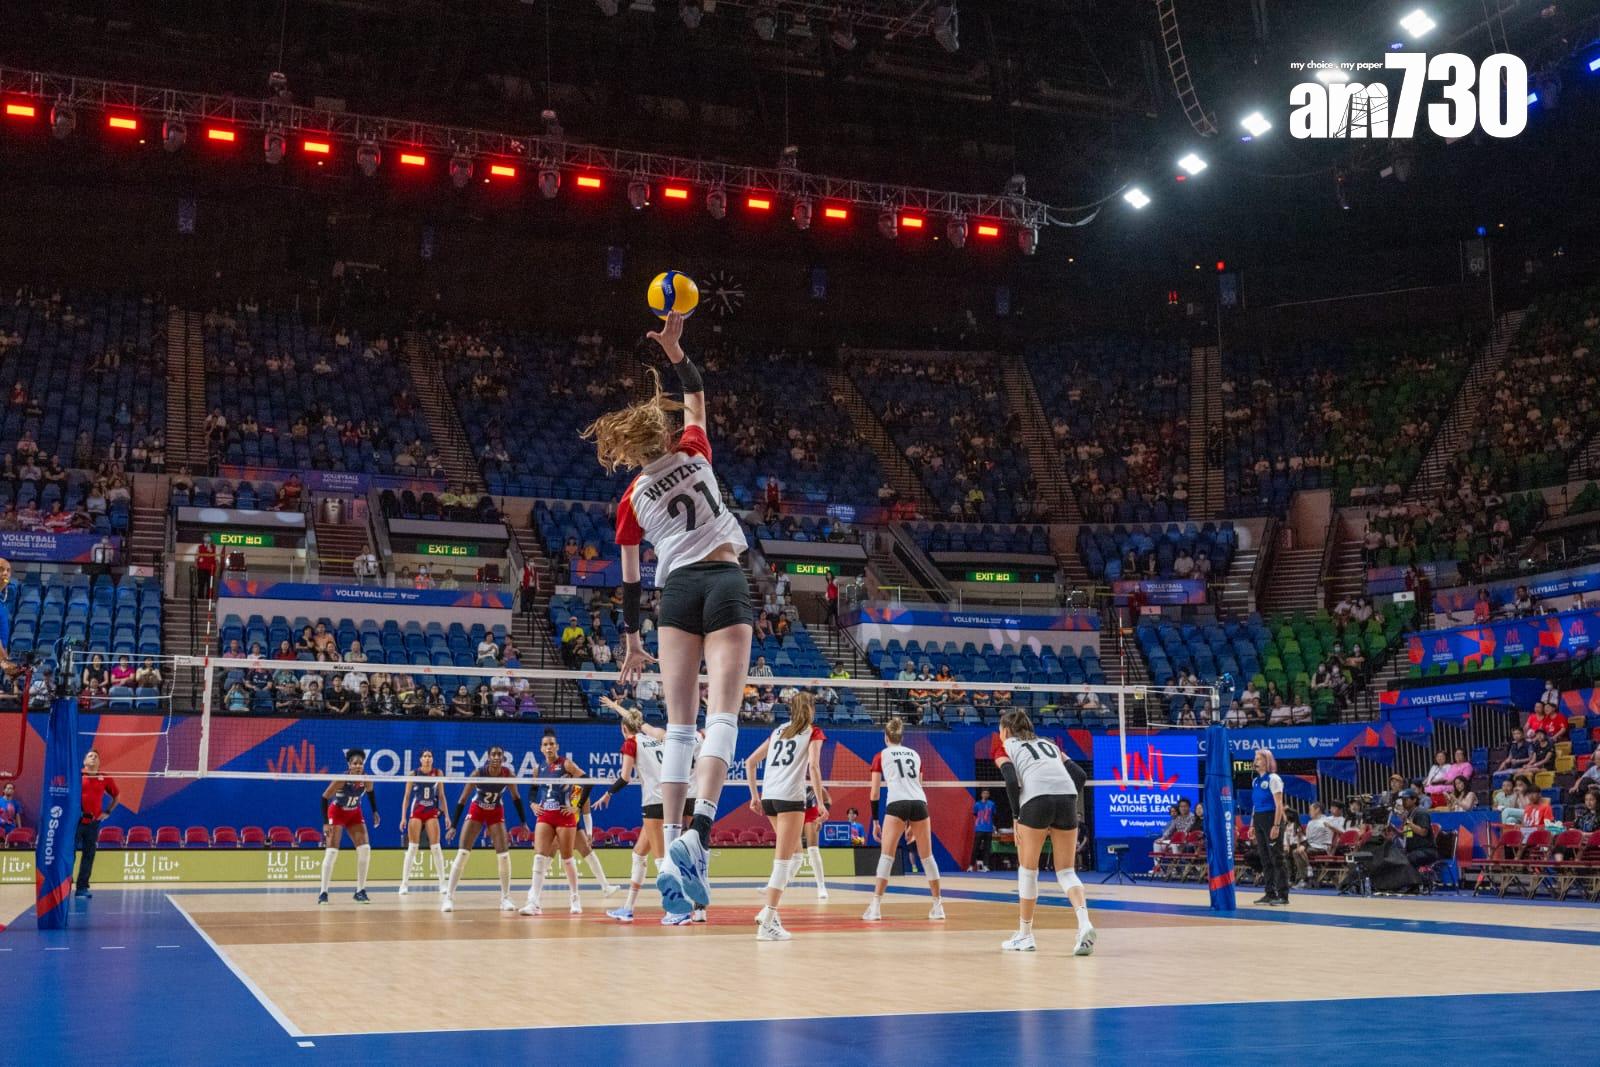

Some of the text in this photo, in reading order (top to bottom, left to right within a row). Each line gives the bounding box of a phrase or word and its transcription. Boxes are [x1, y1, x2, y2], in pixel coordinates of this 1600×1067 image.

[667, 480, 721, 532] 21
[2, 533, 57, 544] VOLLEYBALL
[220, 534, 262, 545] EXIT 出口
[429, 545, 467, 555] EXIT 出口
[796, 565, 815, 573] EXIT
[976, 572, 1010, 581] EXIT 出口
[335, 589, 383, 600] VOLLEYBALL
[952, 616, 990, 625] VOLLEYBALL
[1411, 692, 1453, 705] VOLLEYBALL
[771, 740, 797, 767] 23
[1021, 741, 1057, 761] 10
[894, 758, 916, 779] 13
[423, 787, 430, 799] 8
[1110, 804, 1148, 813] NATIONS
[44, 818, 60, 866] Senoh
[124, 851, 147, 867] LU
[267, 850, 289, 866] LU
[9, 861, 32, 873] LU+
[158, 860, 180, 872] LU+
[300, 860, 321, 870] LU+
